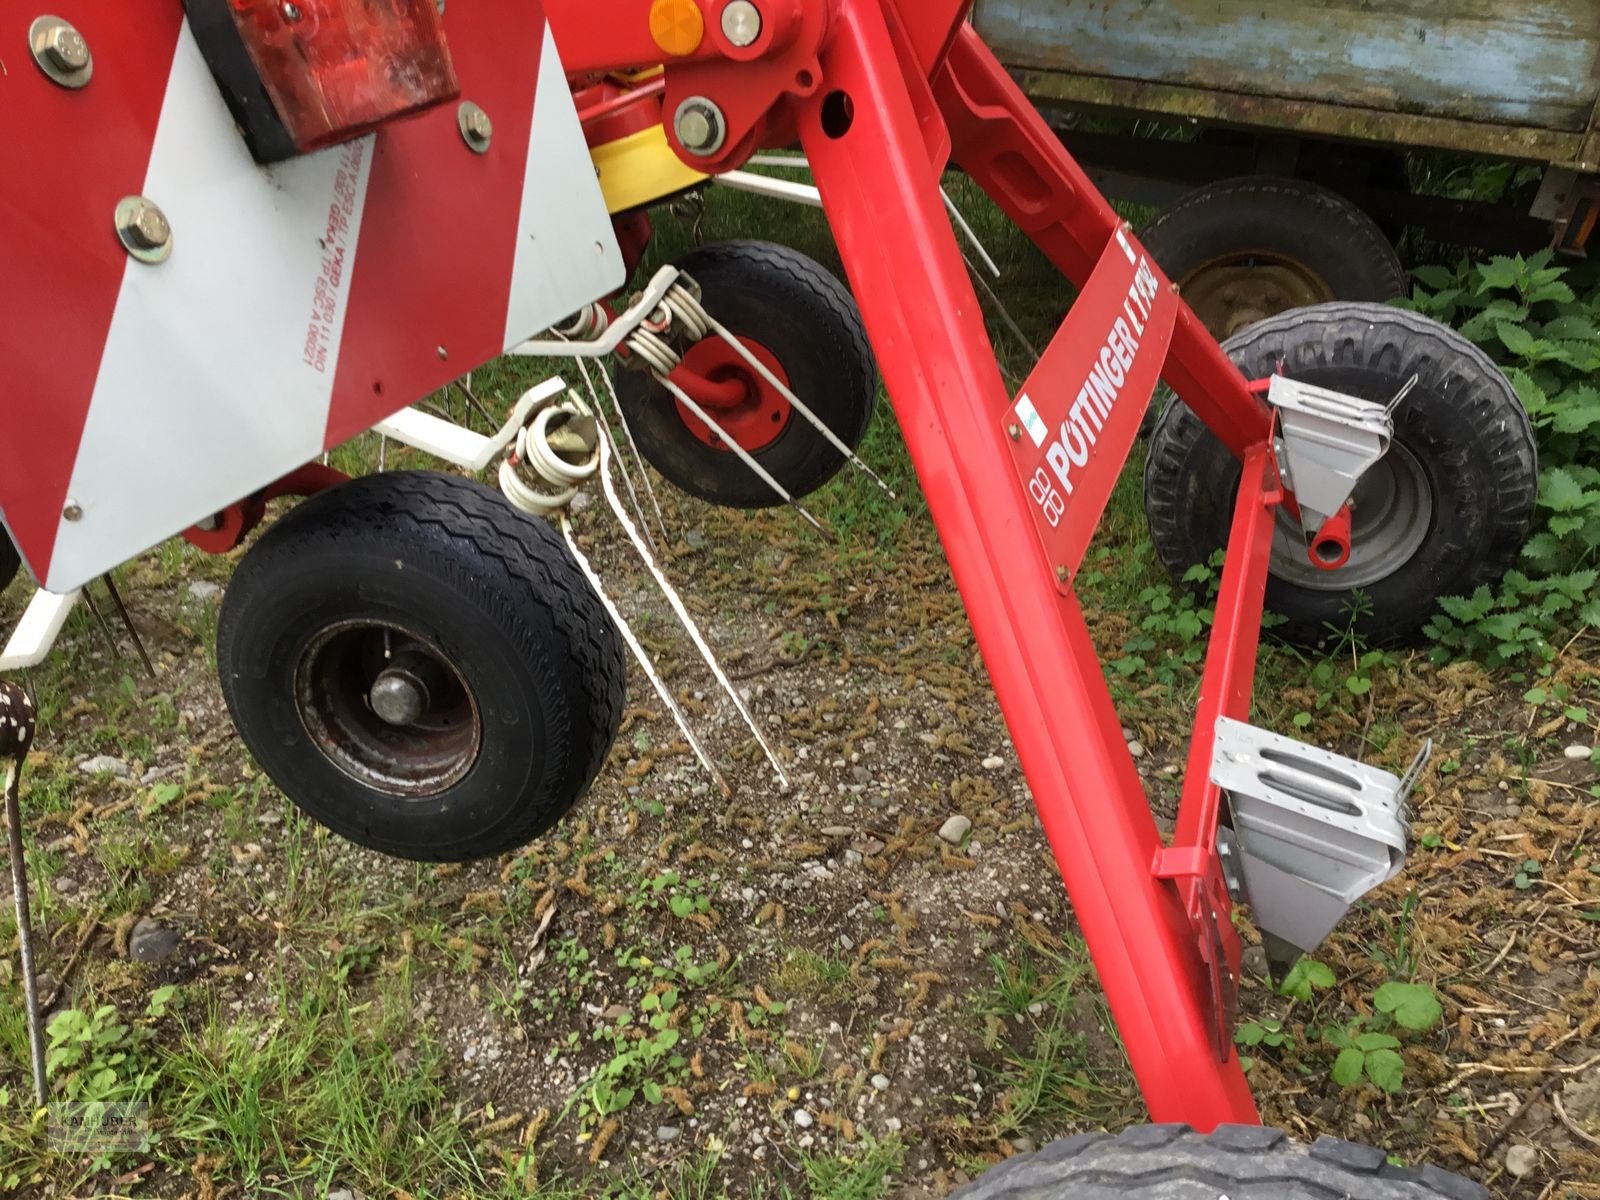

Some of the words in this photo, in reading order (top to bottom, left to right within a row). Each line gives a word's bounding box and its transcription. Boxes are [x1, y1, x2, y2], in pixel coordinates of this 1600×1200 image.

[351, 139, 364, 171] 0602
[349, 173, 357, 185] A
[342, 185, 356, 216] ESC
[326, 203, 340, 244] GEKA
[338, 215, 349, 235] TP
[321, 255, 332, 276] TP
[330, 247, 345, 288] GEKA
[314, 276, 328, 309] ESC
[311, 308, 321, 321] A
[323, 297, 336, 324] 030
[320, 325, 331, 341] 11
[314, 344, 327, 373] DIN
[1046, 316, 1139, 495] PÖTTINGER
